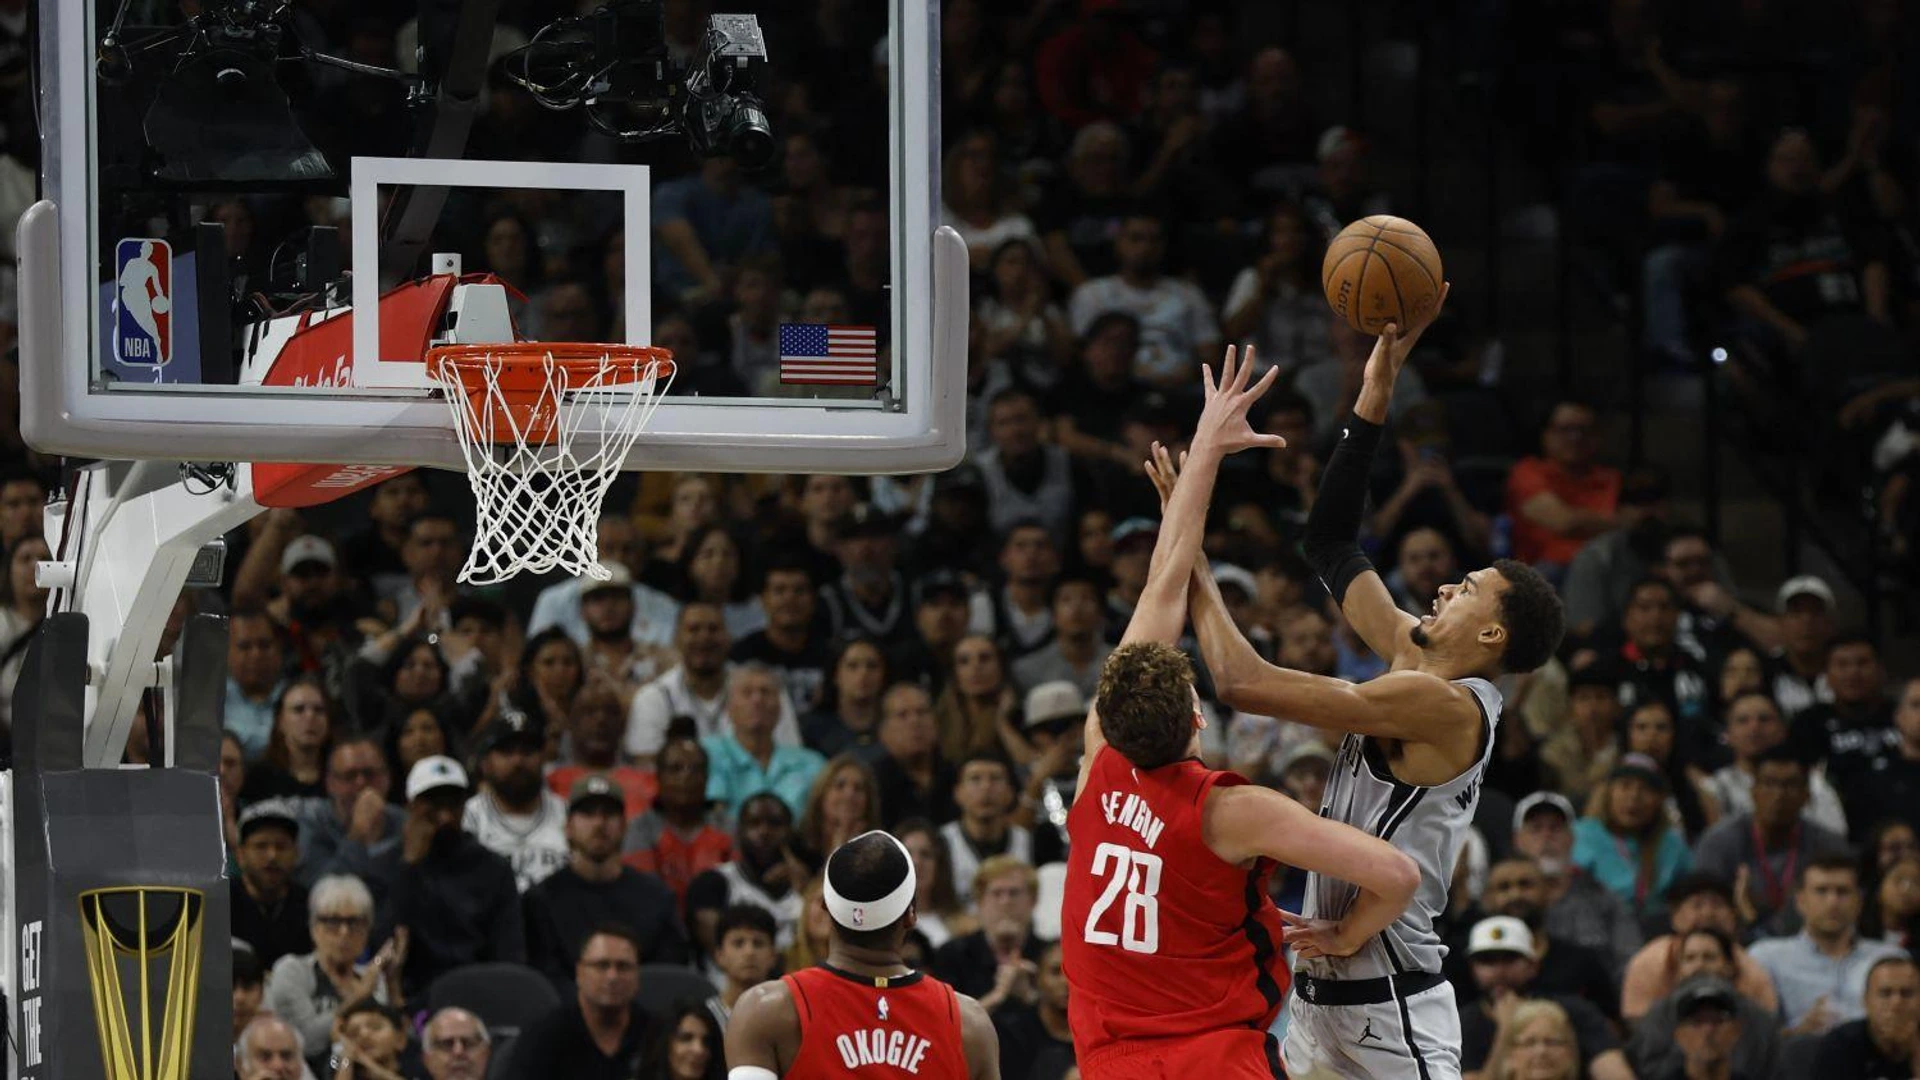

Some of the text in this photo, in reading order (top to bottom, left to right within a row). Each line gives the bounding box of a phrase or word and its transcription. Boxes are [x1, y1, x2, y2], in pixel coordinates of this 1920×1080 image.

[124, 337, 151, 358] NBA
[1084, 842, 1163, 954] 28
[22, 920, 42, 992] GET
[22, 996, 42, 1067] THE
[836, 1028, 932, 1074] OKOGIE
